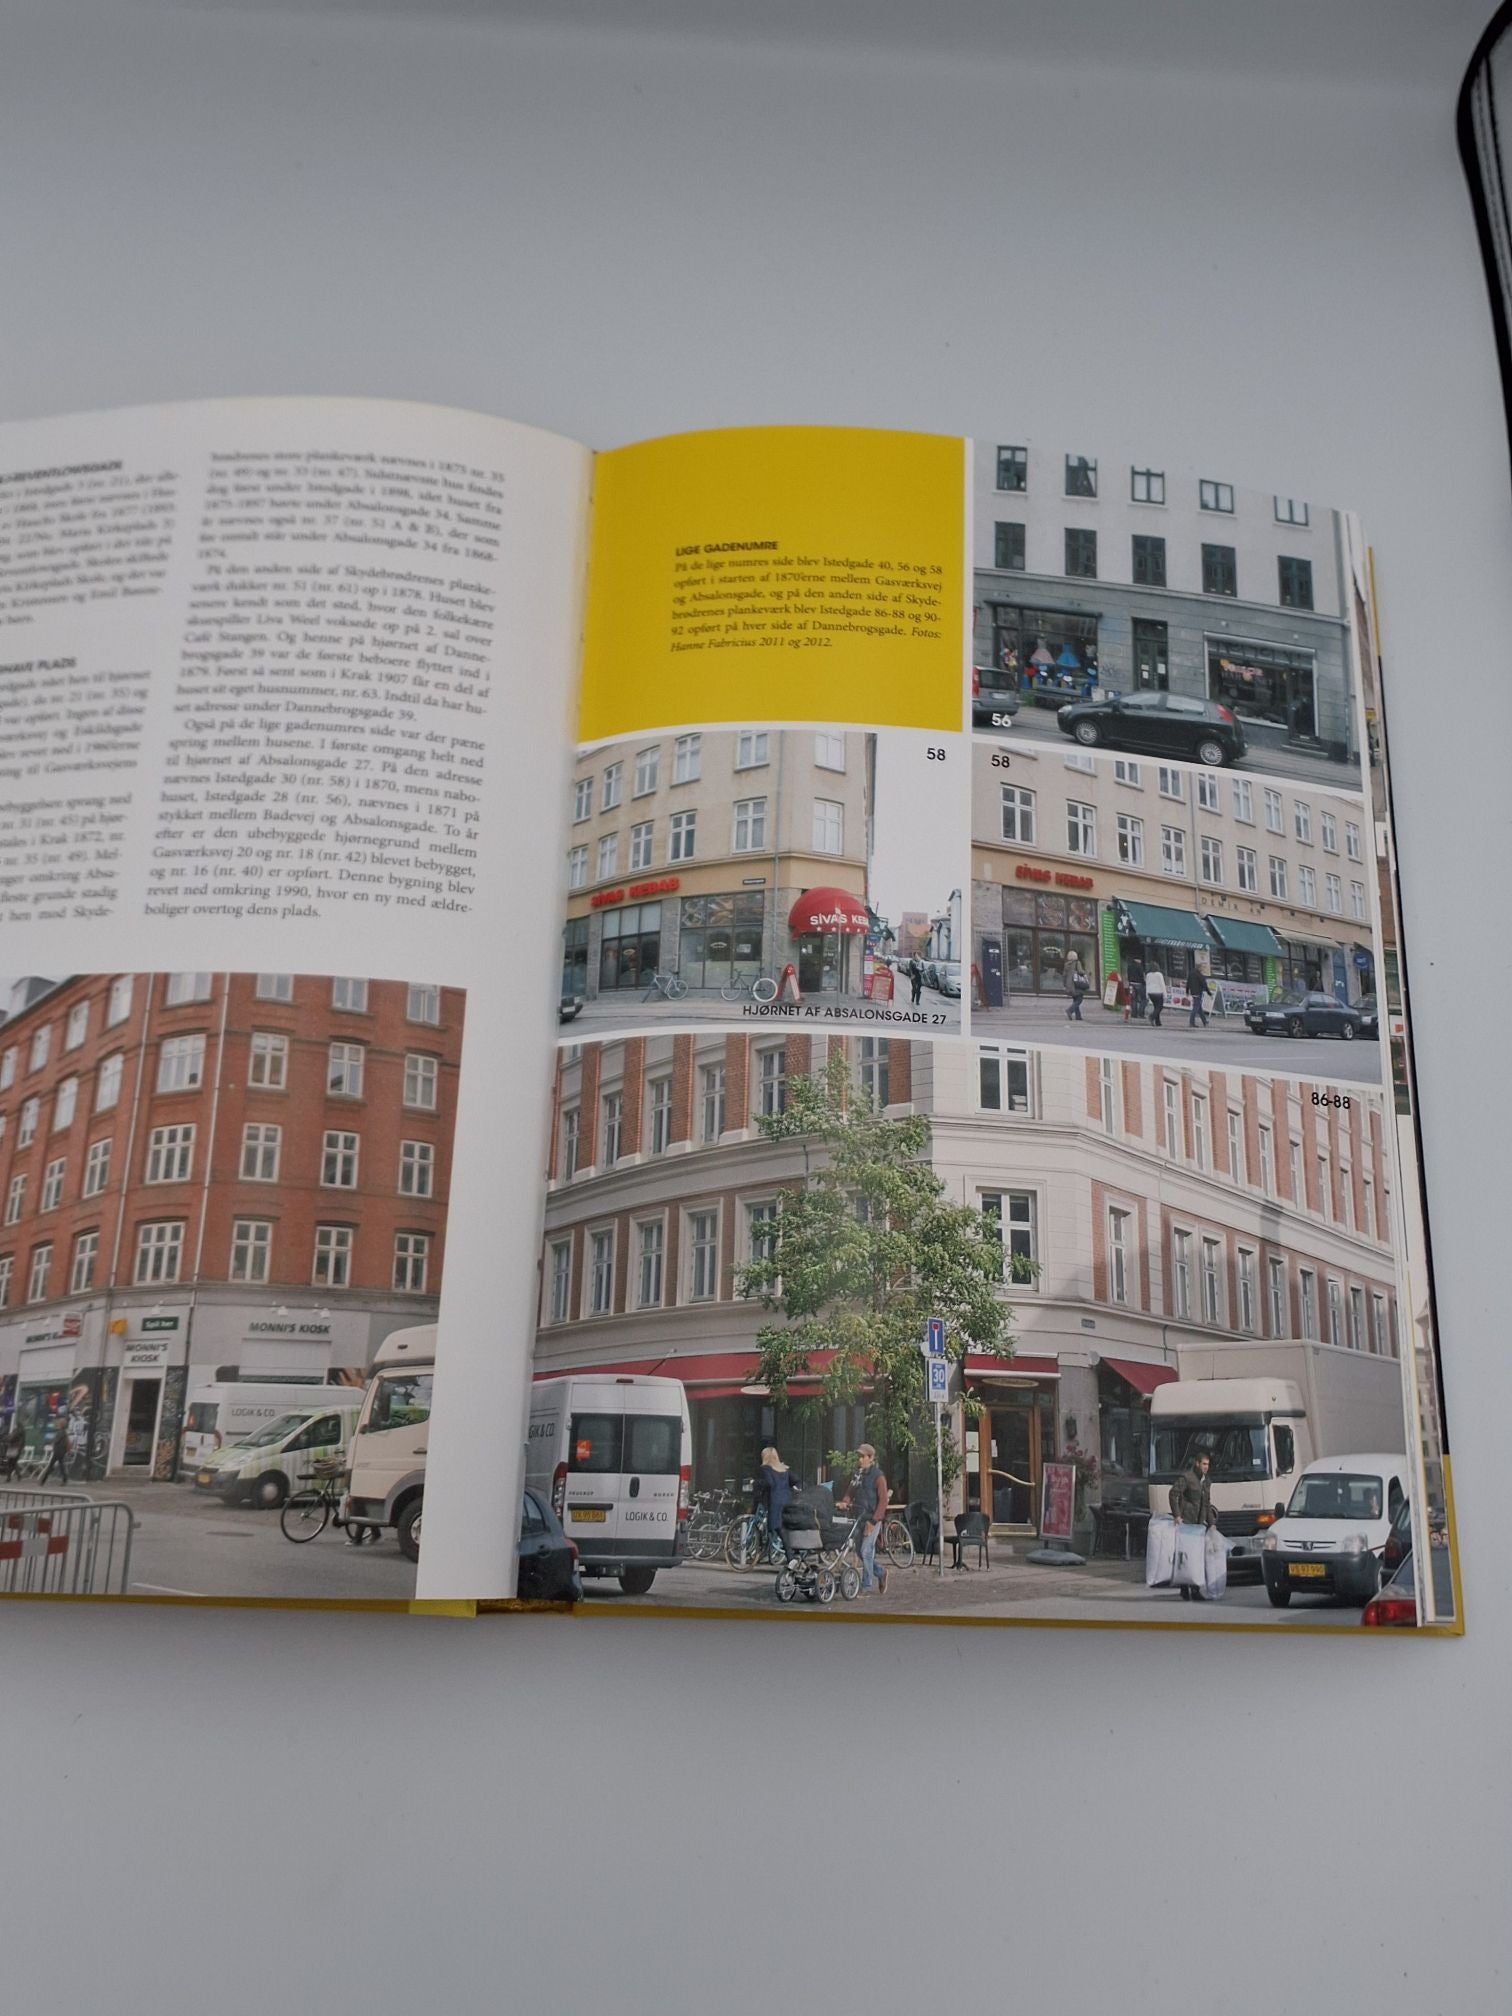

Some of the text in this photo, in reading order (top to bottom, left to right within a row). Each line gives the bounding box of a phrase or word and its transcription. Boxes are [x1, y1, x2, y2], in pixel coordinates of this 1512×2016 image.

[676, 542, 778, 557] LIGE GADENUMRE
[675, 561, 688, 572] På
[690, 560, 704, 570] de
[706, 559, 725, 572] lige
[728, 560, 769, 568] numres
[772, 556, 794, 566] side
[797, 556, 820, 566] blev
[823, 556, 874, 571] Istedgade
[898, 562, 910, 571] 56
[913, 565, 927, 575] og
[930, 564, 943, 574] 58
[674, 576, 706, 590] opført
[718, 574, 755, 584] starten
[760, 572, 771, 582] af
[830, 573, 871, 584] mellem
[875, 575, 942, 594] Gasværksvej
[673, 596, 686, 606] og
[770, 591, 783, 601] og
[787, 588, 800, 601] på
[804, 588, 825, 598] den
[829, 589, 862, 600] anden
[867, 591, 888, 602] side
[892, 593, 903, 603] af
[672, 607, 725, 619] brødrenes
[728, 603, 791, 618] plankeværk
[794, 603, 816, 613] blev
[820, 604, 871, 618] Istedgade
[874, 608, 905, 618] 86-88
[908, 612, 922, 623] og
[671, 625, 684, 634] 92
[688, 622, 720, 636] opført
[725, 621, 738, 634] på
[743, 620, 766, 630] hver
[771, 620, 793, 630] side
[797, 620, 807, 630] af
[759, 637, 785, 646] 2011
[788, 639, 801, 649] og
[991, 712, 1012, 727] 56
[184, 717, 485, 751] Også på de lige gadenumres side var der pæne
[169, 736, 208, 752] spring
[213, 735, 260, 748] mellem
[331, 738, 368, 753] første
[372, 745, 426, 763] omgang
[431, 748, 455, 763] helt
[460, 755, 484, 767] ned
[926, 747, 946, 762] 58
[166, 754, 179, 766] til
[186, 753, 231, 770] hjørnet
[238, 753, 251, 766] af
[258, 753, 347, 772] Absalonsgade
[382, 760, 397, 773] På
[404, 762, 429, 777] den
[436, 767, 483, 785] adresse
[991, 754, 1010, 768] 58
[164, 775, 211, 784] nævnes
[215, 771, 276, 788] Istedgade
[282, 774, 297, 785] 30
[329, 775, 350, 792] 58)
[404, 785, 439, 798] mens
[205, 789, 266, 806] Istedgade
[273, 792, 288, 803] 28
[358, 799, 409, 812] nævnes
[429, 804, 456, 818] 1871
[465, 809, 480, 824] på
[158, 808, 203, 825] stykket
[209, 808, 257, 821] mellem
[263, 809, 315, 827] Badevej
[320, 815, 337, 828] og
[444, 823, 461, 837] To
[466, 826, 478, 840] år
[155, 826, 477, 858] efter er den ubebyggede hjørnegrund mellem
[152, 845, 233, 862] Gasværksvej
[237, 847, 253, 858] 20
[255, 850, 273, 863] og
[299, 849, 314, 860] 18
[345, 850, 367, 867] 42)
[371, 851, 410, 867] blevet
[150, 868, 166, 881] og
[194, 866, 208, 876] 16
[242, 864, 263, 881] 40)
[268, 869, 282, 877] er
[339, 868, 383, 884] Denne
[388, 872, 443, 894] bygning
[448, 880, 475, 895] blev
[148, 885, 178, 896] revet
[184, 883, 208, 896] ned
[212, 883, 271, 900] omkring
[317, 886, 348, 899] hvor
[353, 892, 369, 901] en
[375, 893, 391, 907] ny
[397, 894, 426, 906] med
[145, 902, 189, 919] boliger
[193, 904, 243, 919] overtog
[246, 903, 278, 916] dens
[743, 1005, 947, 1025] HJØRNET AF ABSALONSGADE 27
[1311, 1092, 1350, 1110] 86-88
[249, 1322, 331, 1334] MONNI'S KIOSK
[933, 1368, 945, 1383] 30
[625, 1512, 648, 1521] LOGIK
[649, 1512, 655, 1521] &
